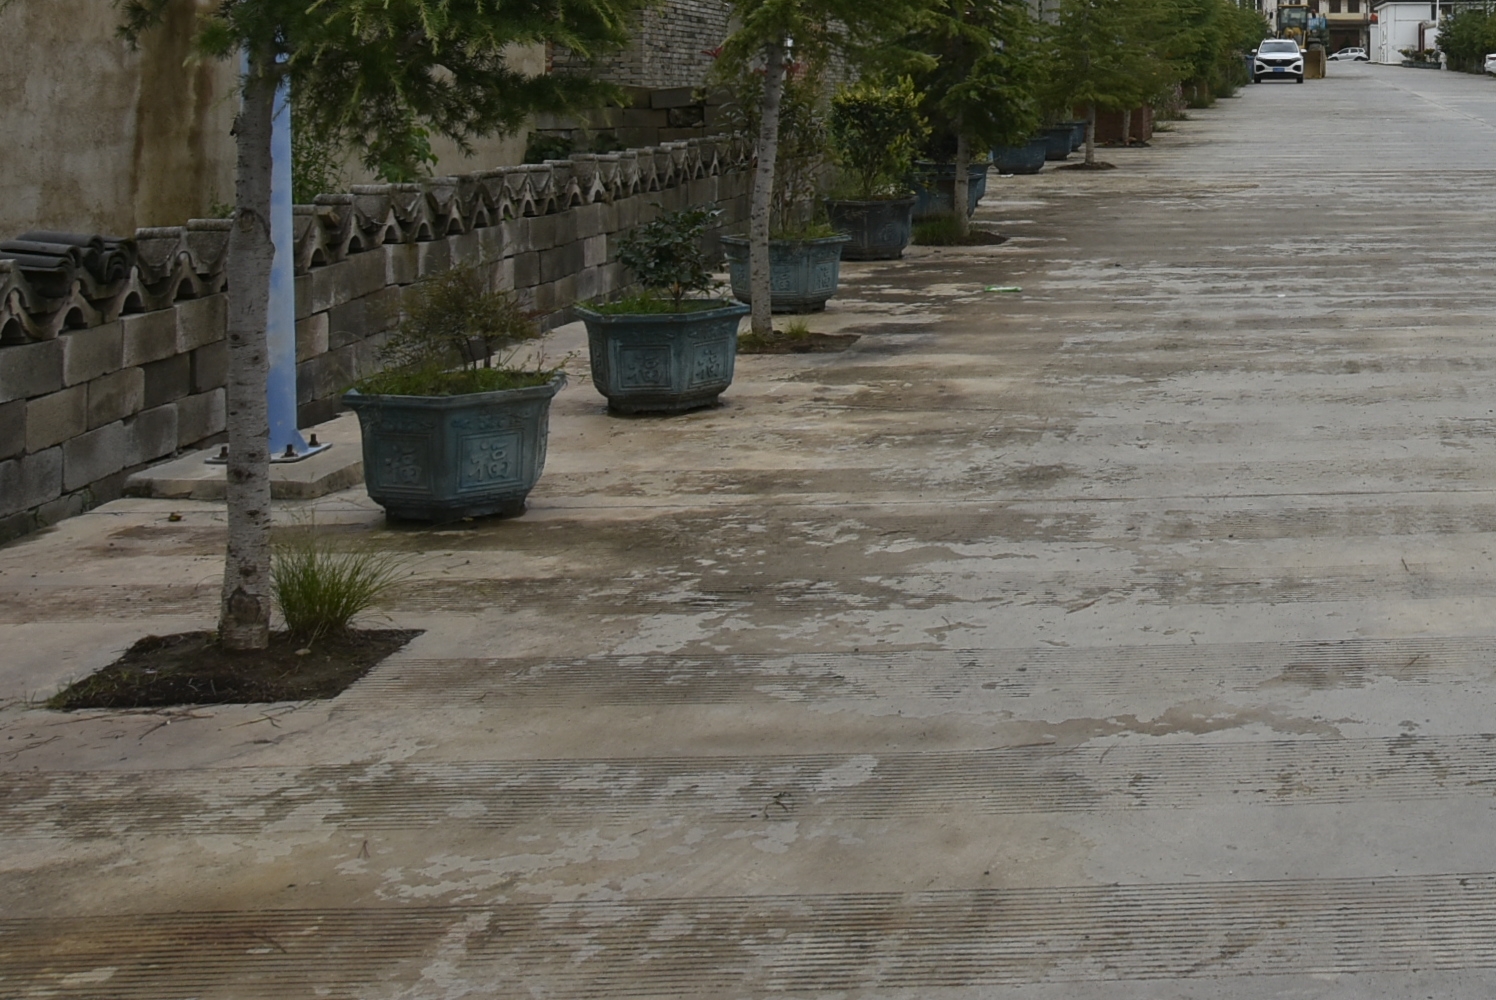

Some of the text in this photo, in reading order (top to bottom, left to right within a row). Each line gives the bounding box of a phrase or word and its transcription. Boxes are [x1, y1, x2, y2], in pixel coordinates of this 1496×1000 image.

[627, 352, 661, 384] 福
[384, 441, 422, 484] 福
[468, 441, 512, 482] 福
